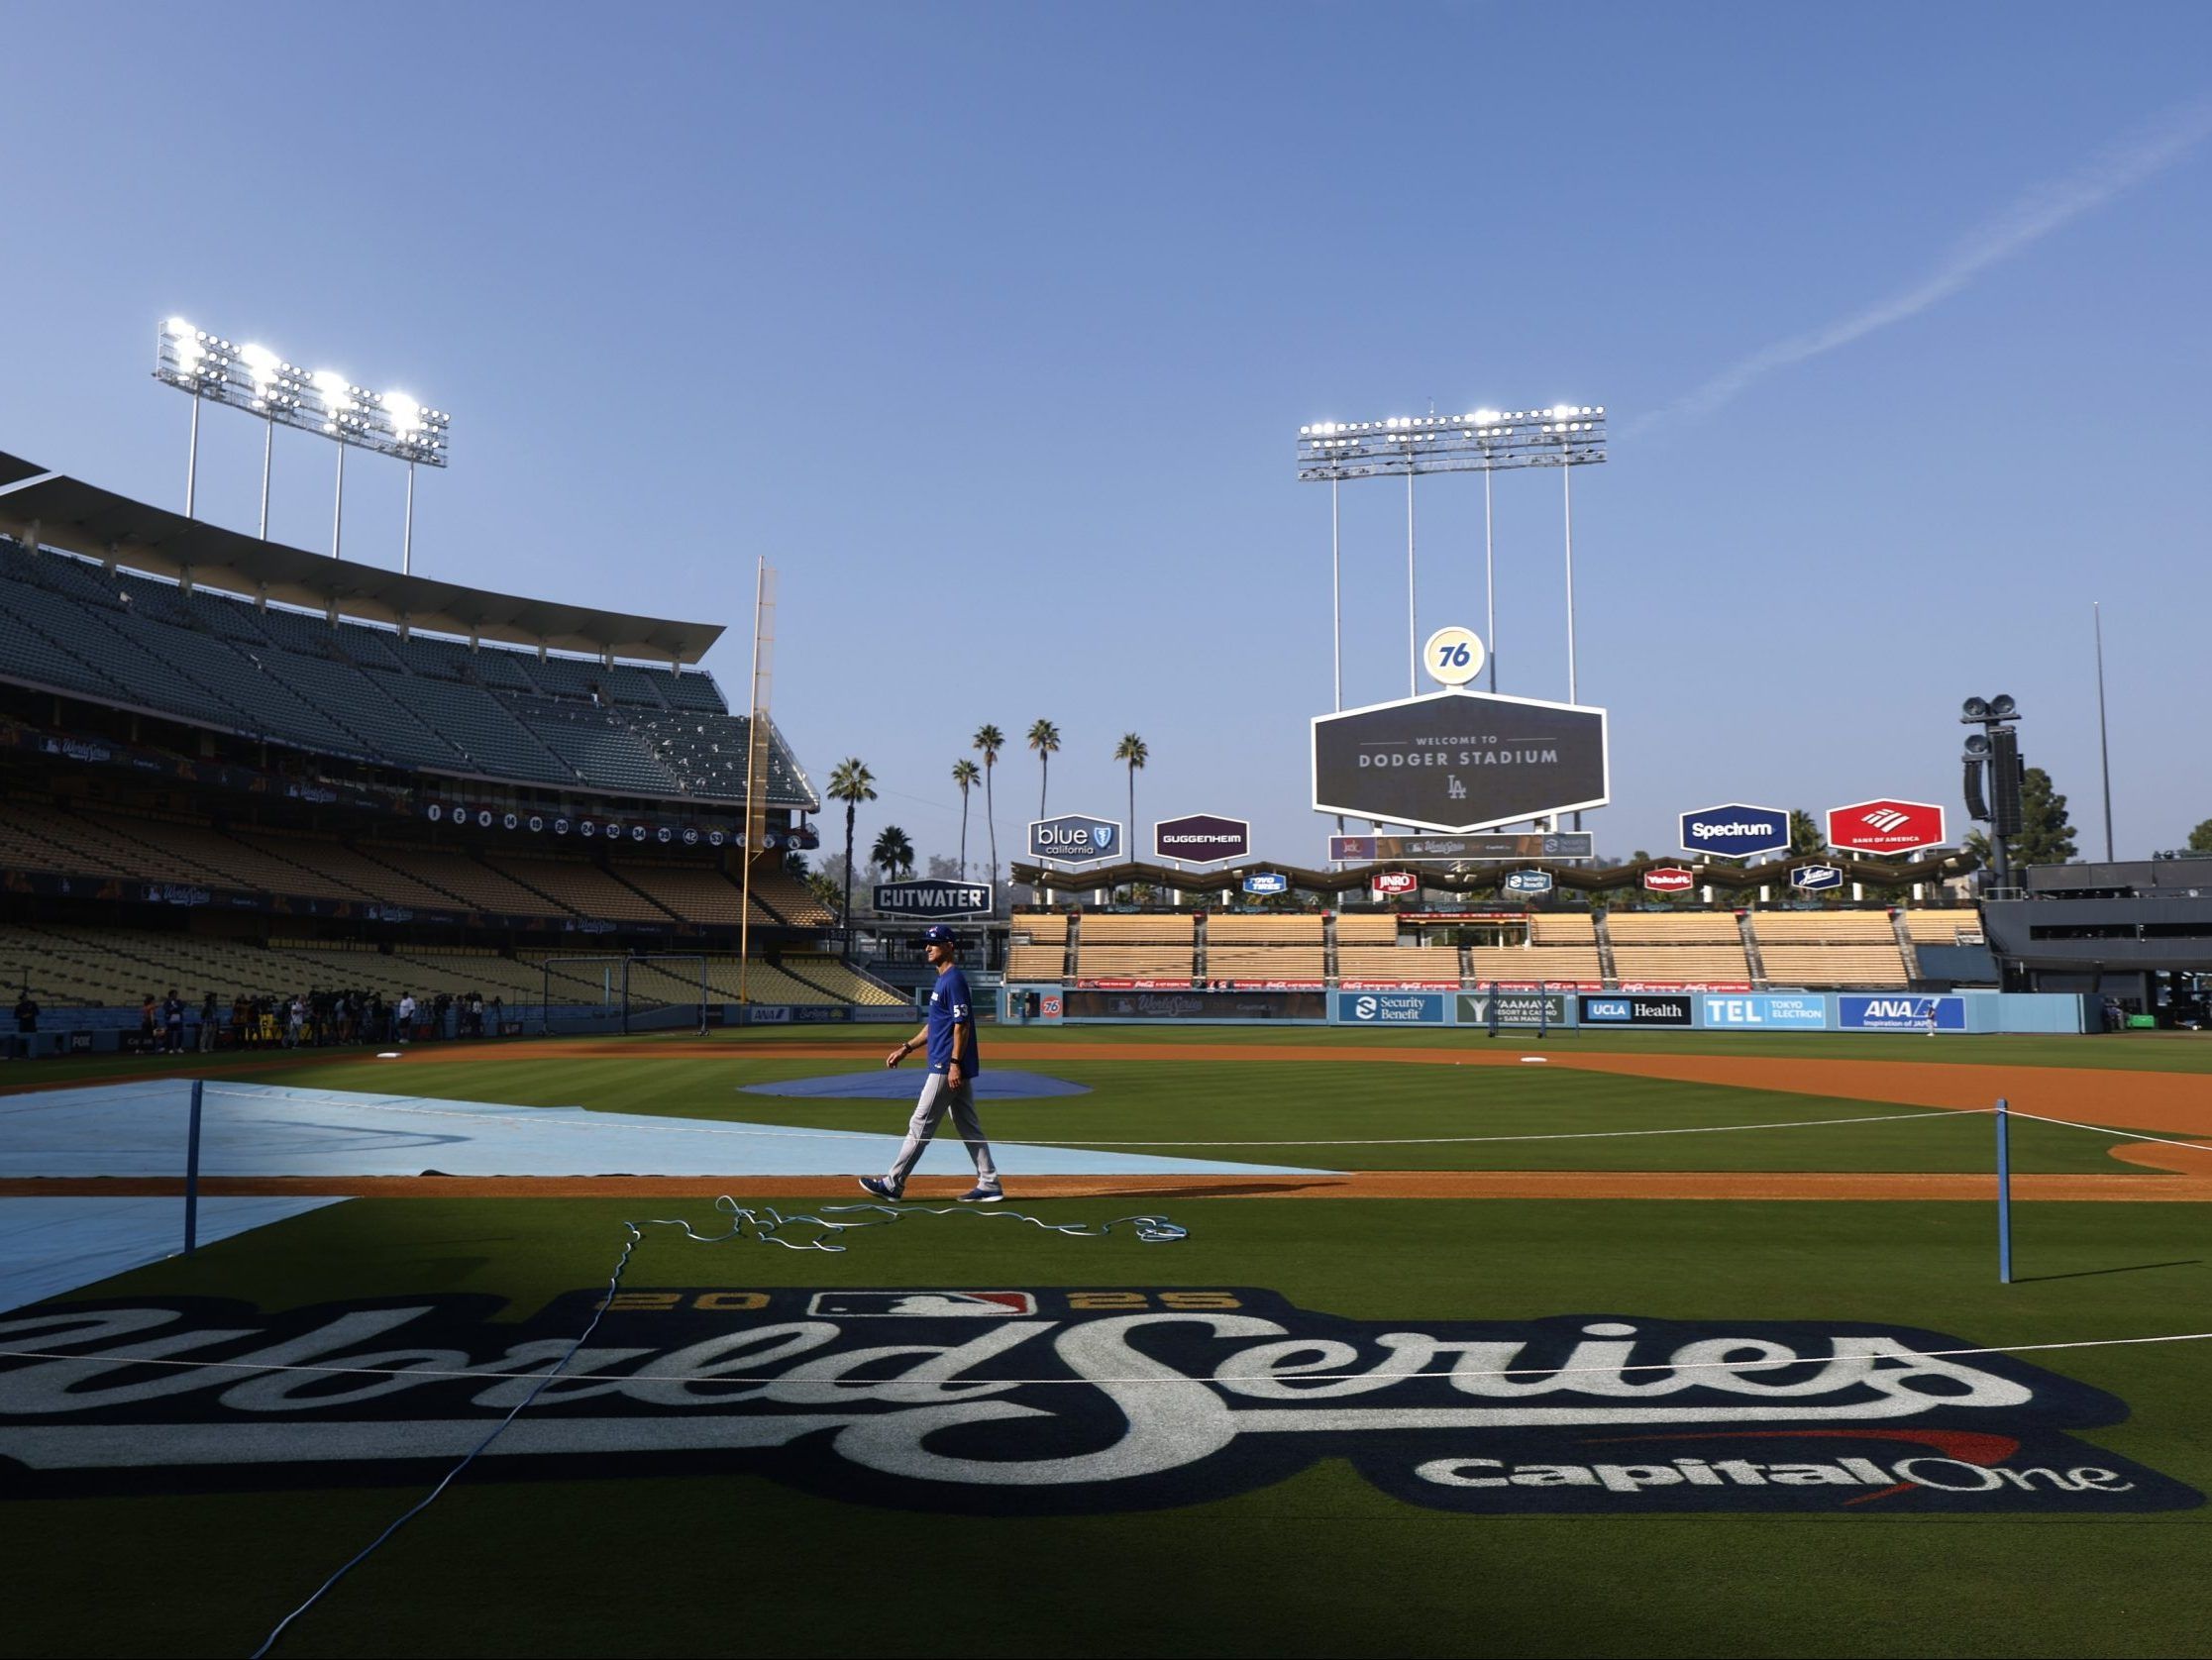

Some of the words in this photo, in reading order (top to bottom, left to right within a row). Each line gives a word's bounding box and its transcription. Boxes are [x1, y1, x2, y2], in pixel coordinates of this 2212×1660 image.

[1438, 642, 1471, 668] 76
[1416, 737, 1477, 746] WELCOME
[1359, 752, 1448, 768] DODGER
[1460, 750, 1558, 766] STADIUM
[557, 822, 567, 832] 20
[582, 825, 593, 834] 24
[608, 827, 619, 836] 32
[634, 829, 645, 838] 34
[660, 830, 670, 839] 39
[685, 831, 695, 841] 42
[711, 833, 722, 842] 53
[1038, 825, 1088, 844] blue
[1692, 822, 1772, 839] Spectrum
[1379, 876, 1410, 888] JINRO
[880, 889, 982, 907] CUTWATER
[953, 1003, 969, 1018] 53
[1042, 1000, 1059, 1013] 76
[1380, 996, 1425, 1009] Security
[1593, 1004, 1627, 1015] UCLA
[1634, 1003, 1682, 1017] Health
[1707, 1000, 1762, 1022] TEL
[1863, 1000, 1913, 1017] ANA
[1381, 1009, 1420, 1019] Benefit
[72, 1035, 91, 1047] FOX
[602, 1291, 771, 1311] 20
[1065, 1291, 1243, 1310] 25
[1893, 1456, 2135, 1494] One
